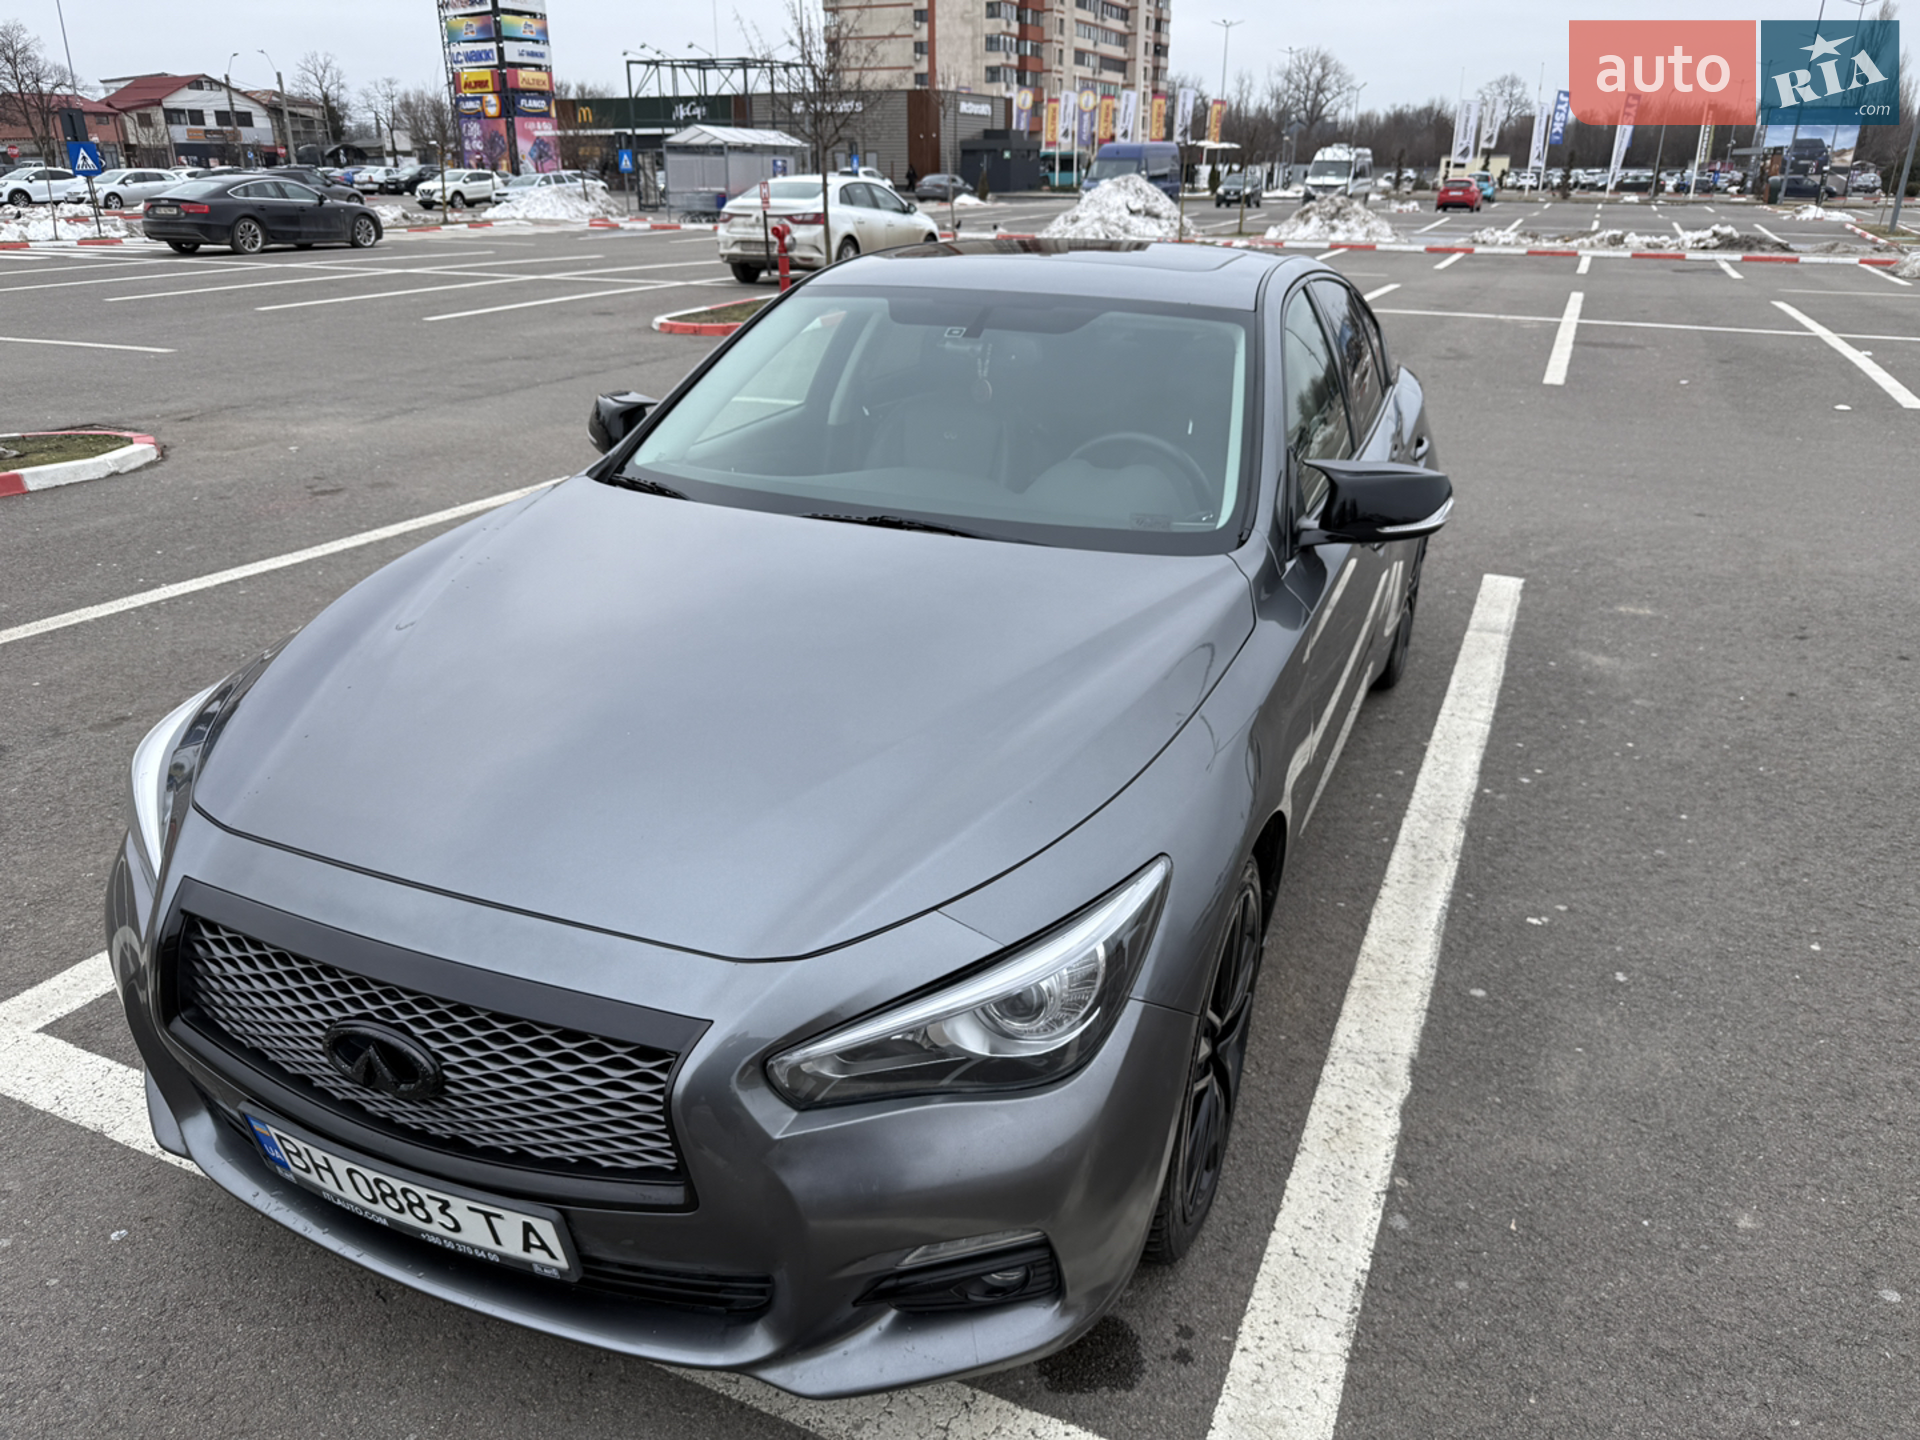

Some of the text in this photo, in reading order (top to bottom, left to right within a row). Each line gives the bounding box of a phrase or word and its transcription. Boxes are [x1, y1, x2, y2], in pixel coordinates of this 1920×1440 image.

[452, 51, 463, 65] LC
[518, 49, 525, 57] LC
[521, 77, 547, 87] ALTEX
[520, 98, 547, 109] FLANCO
[1551, 92, 1569, 135] JYSK
[263, 1144, 285, 1161] UA
[274, 1132, 345, 1192] BH
[346, 1167, 462, 1233] 0883
